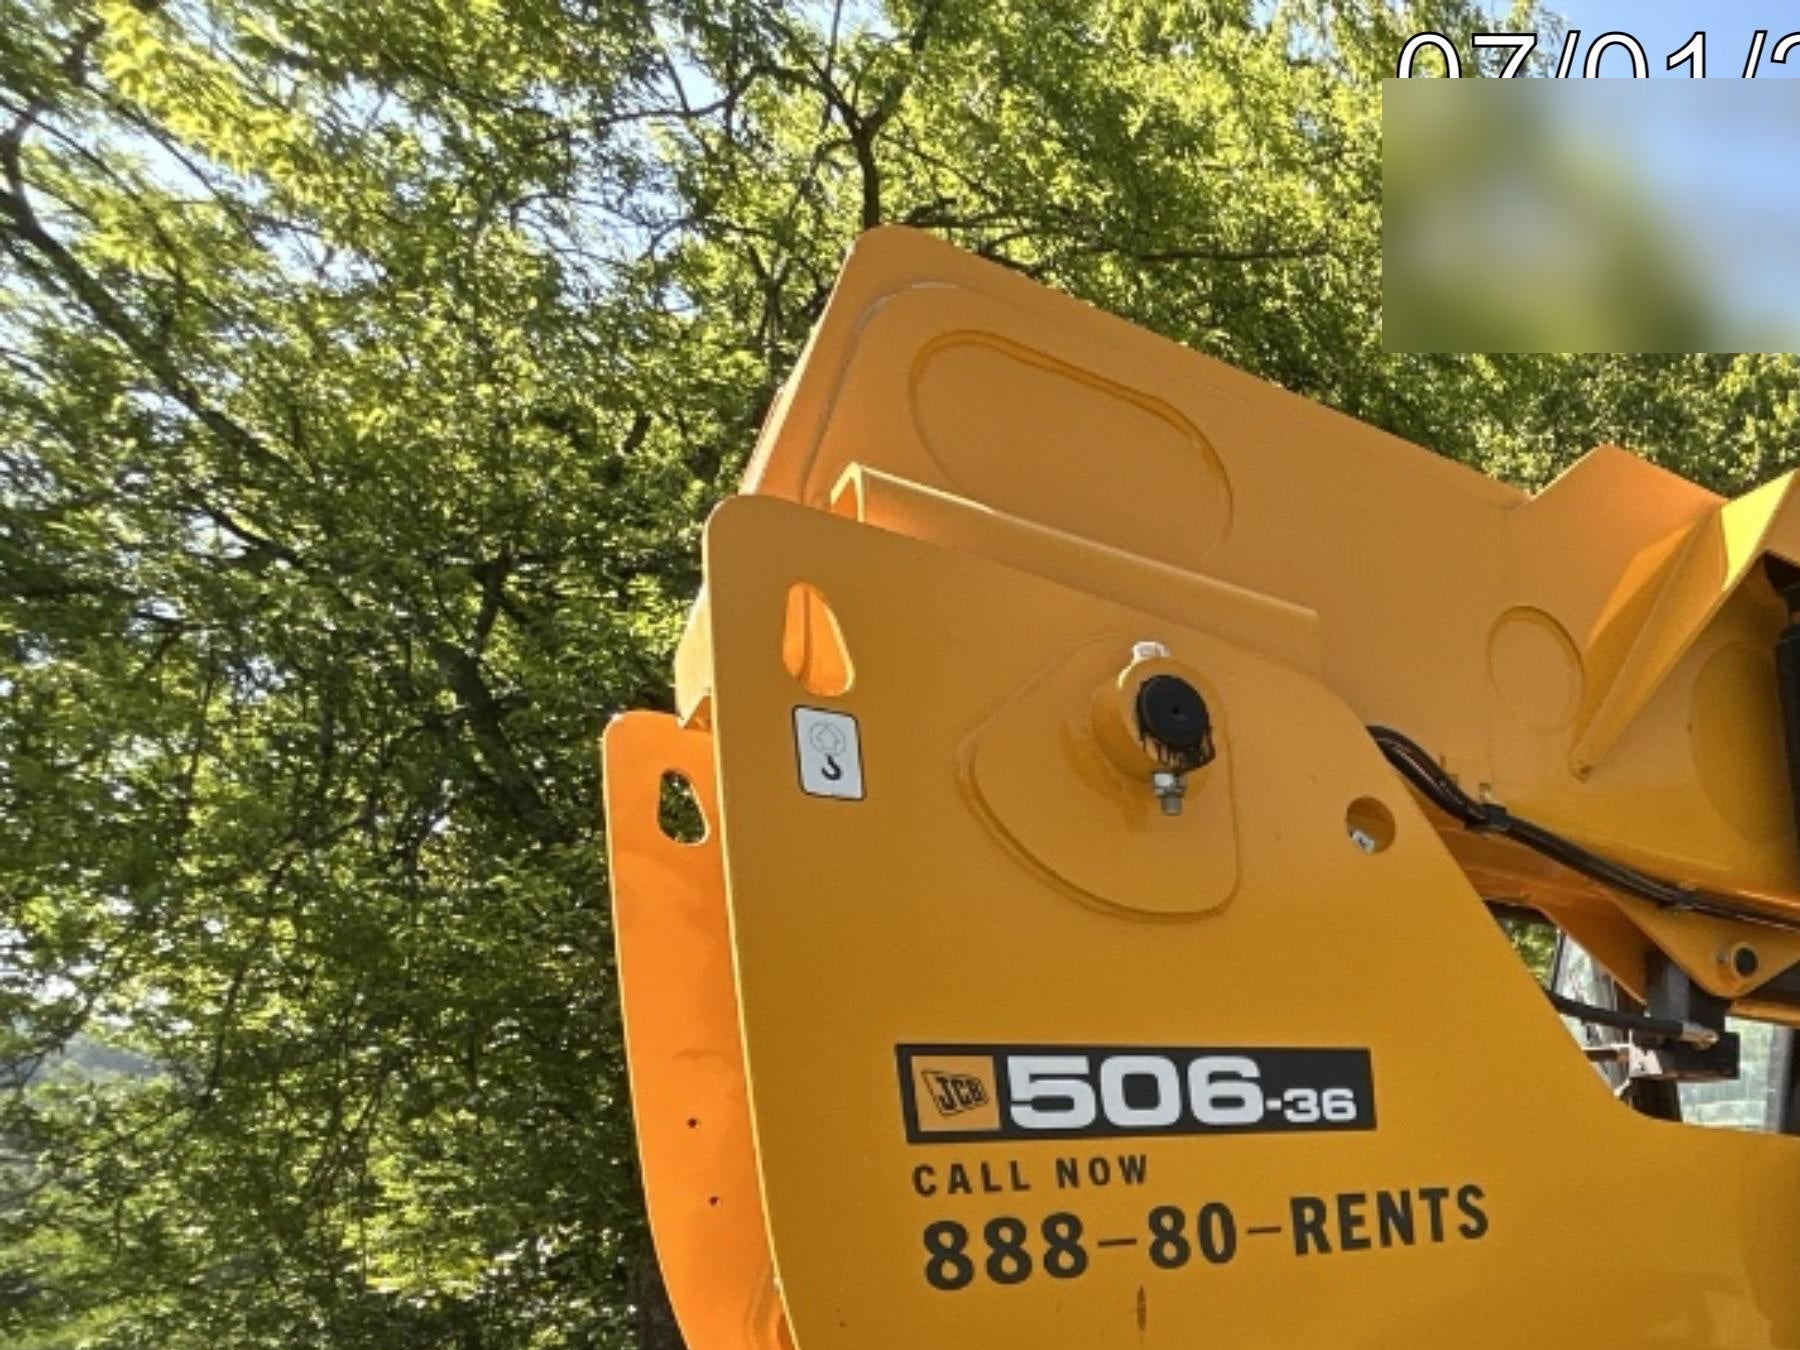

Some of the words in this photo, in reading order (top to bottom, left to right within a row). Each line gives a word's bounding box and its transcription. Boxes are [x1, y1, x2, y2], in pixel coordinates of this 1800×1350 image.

[930, 1073, 986, 1113] JCB
[1006, 1055, 1358, 1130] 506-36
[912, 1160, 1030, 1197] CALL
[1055, 1155, 1149, 1189] NOW
[922, 1184, 1490, 1292] 888-80-RENTS
